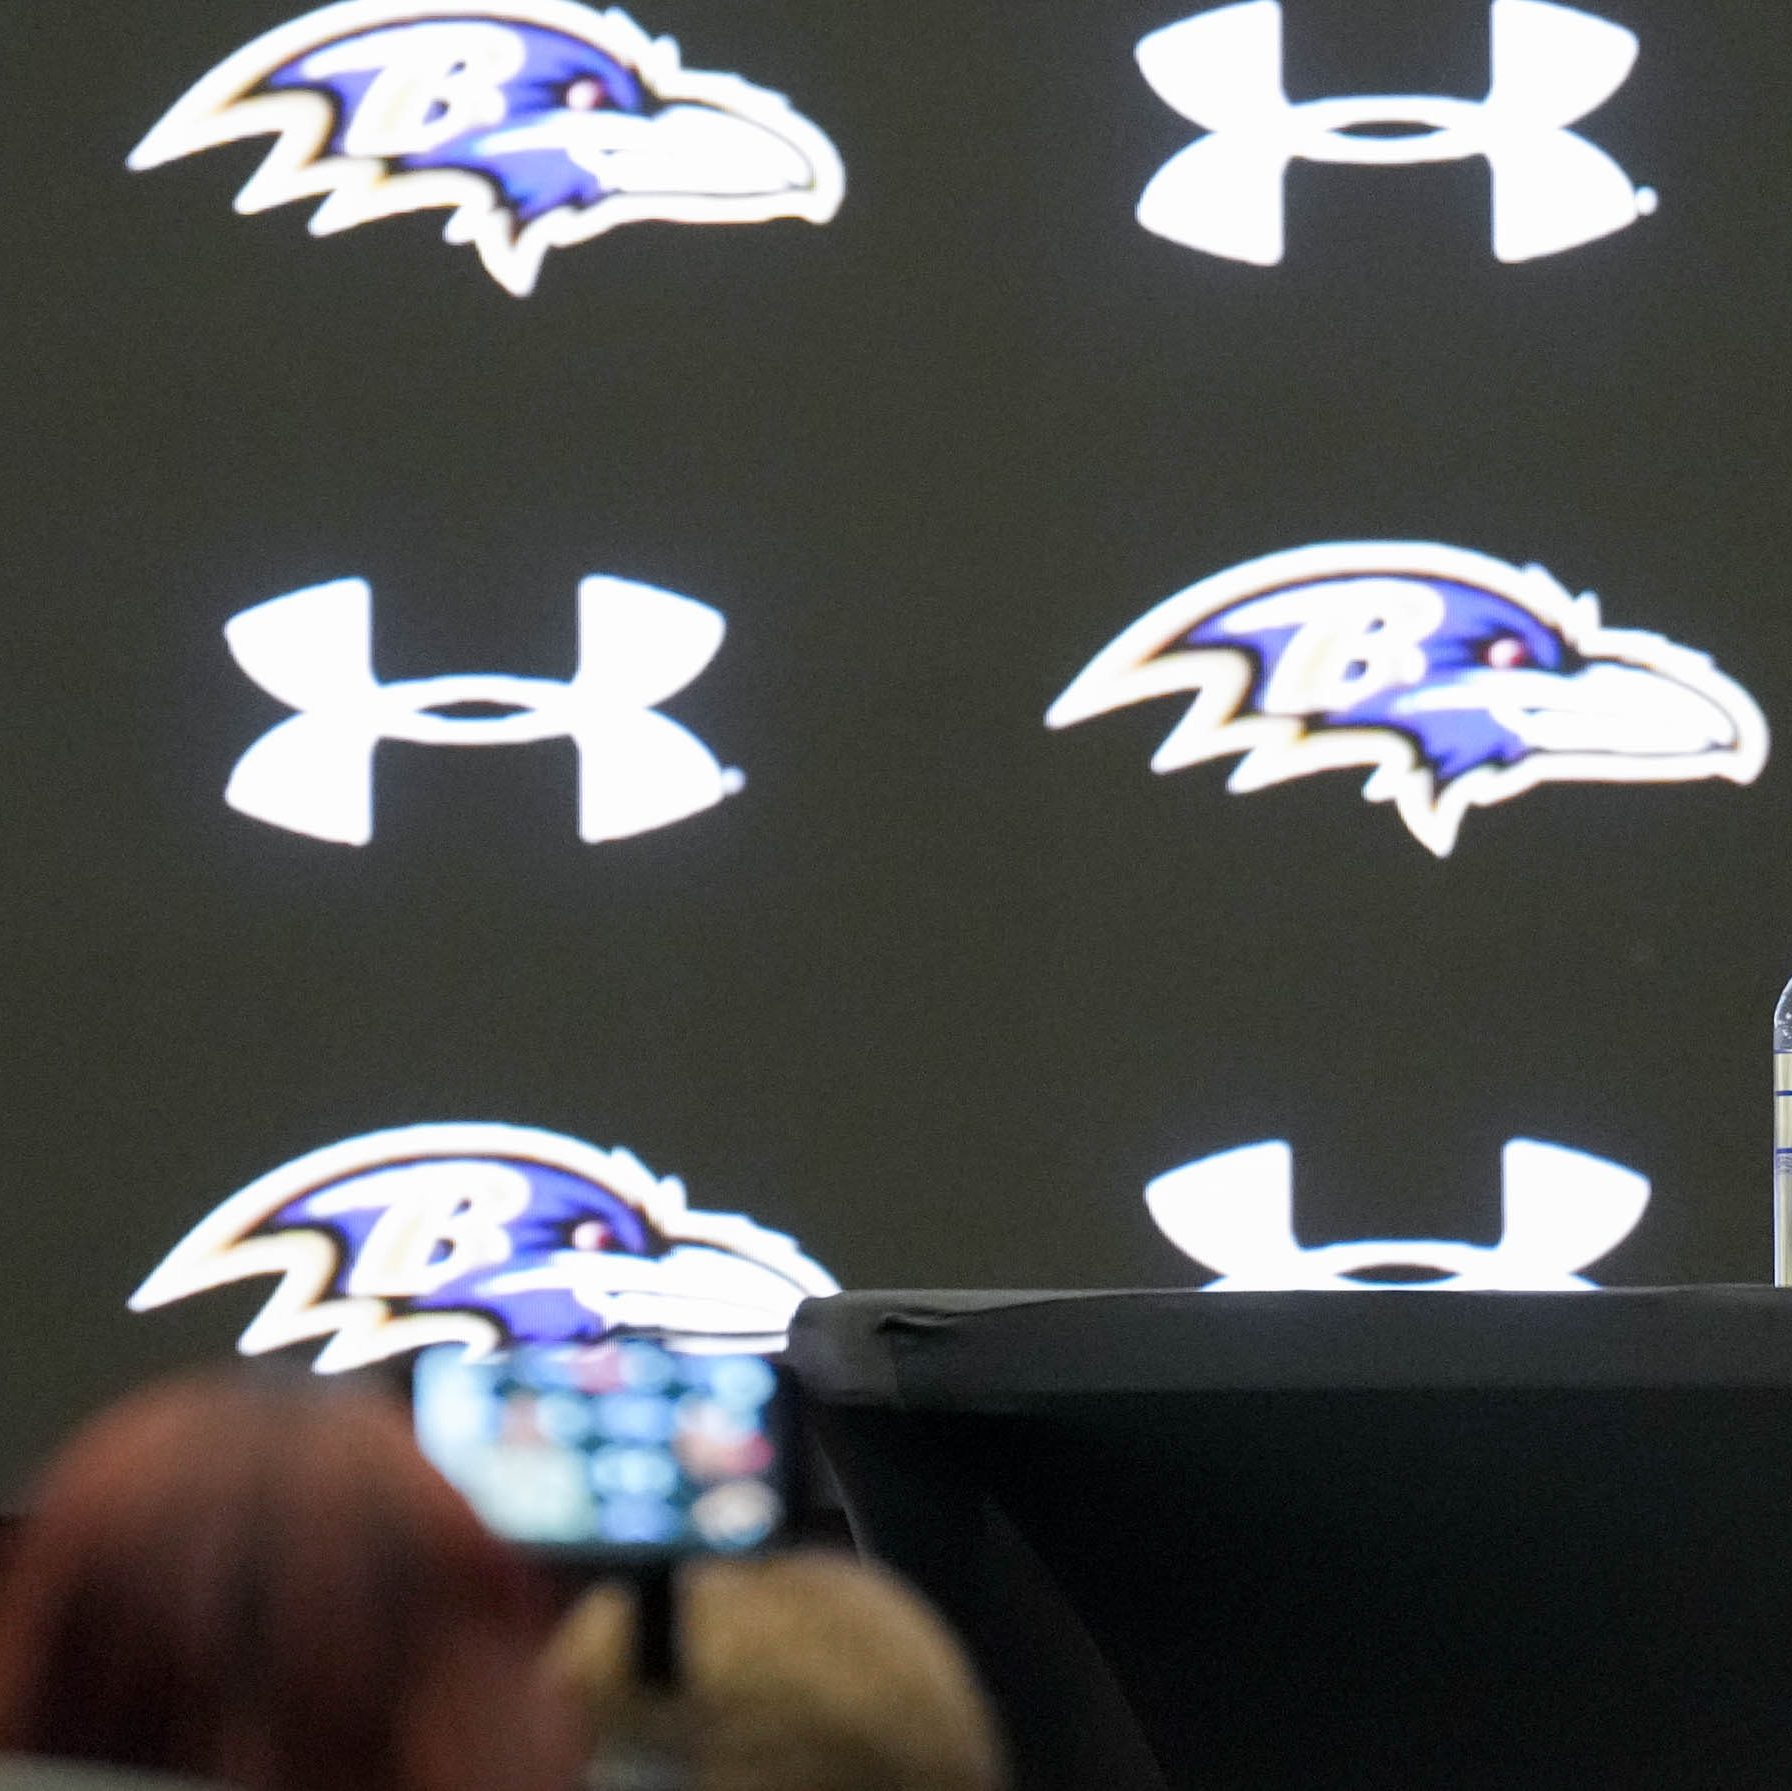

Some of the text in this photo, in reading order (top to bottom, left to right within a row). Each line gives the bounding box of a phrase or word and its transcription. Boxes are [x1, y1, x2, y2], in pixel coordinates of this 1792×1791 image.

[299, 20, 526, 157] B
[1218, 577, 1445, 714] B
[304, 1159, 531, 1296] B
